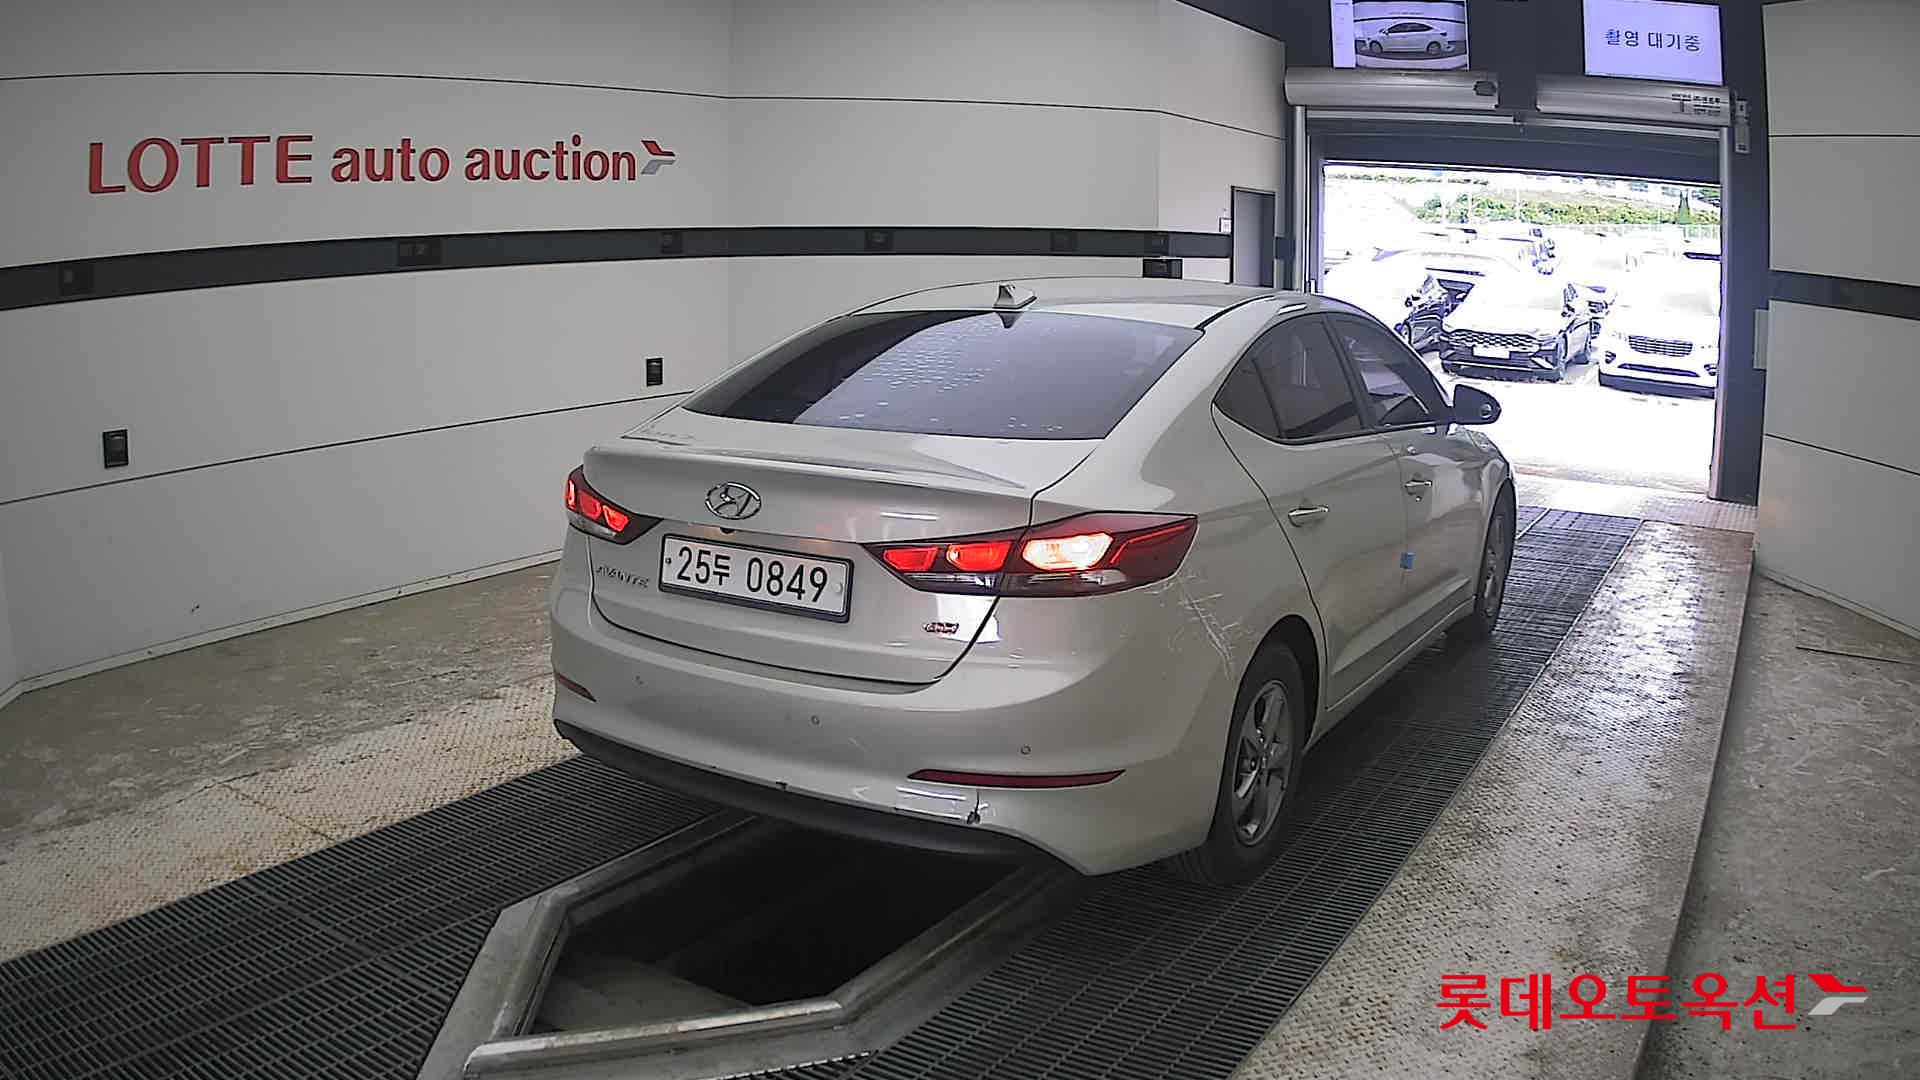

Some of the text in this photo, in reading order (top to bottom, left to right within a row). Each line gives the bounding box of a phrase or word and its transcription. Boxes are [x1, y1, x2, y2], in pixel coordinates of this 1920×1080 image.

[1647, 31, 1701, 52] 대기중
[88, 133, 637, 194] LOTTE auto auction
[676, 546, 828, 603] 25두 0849
